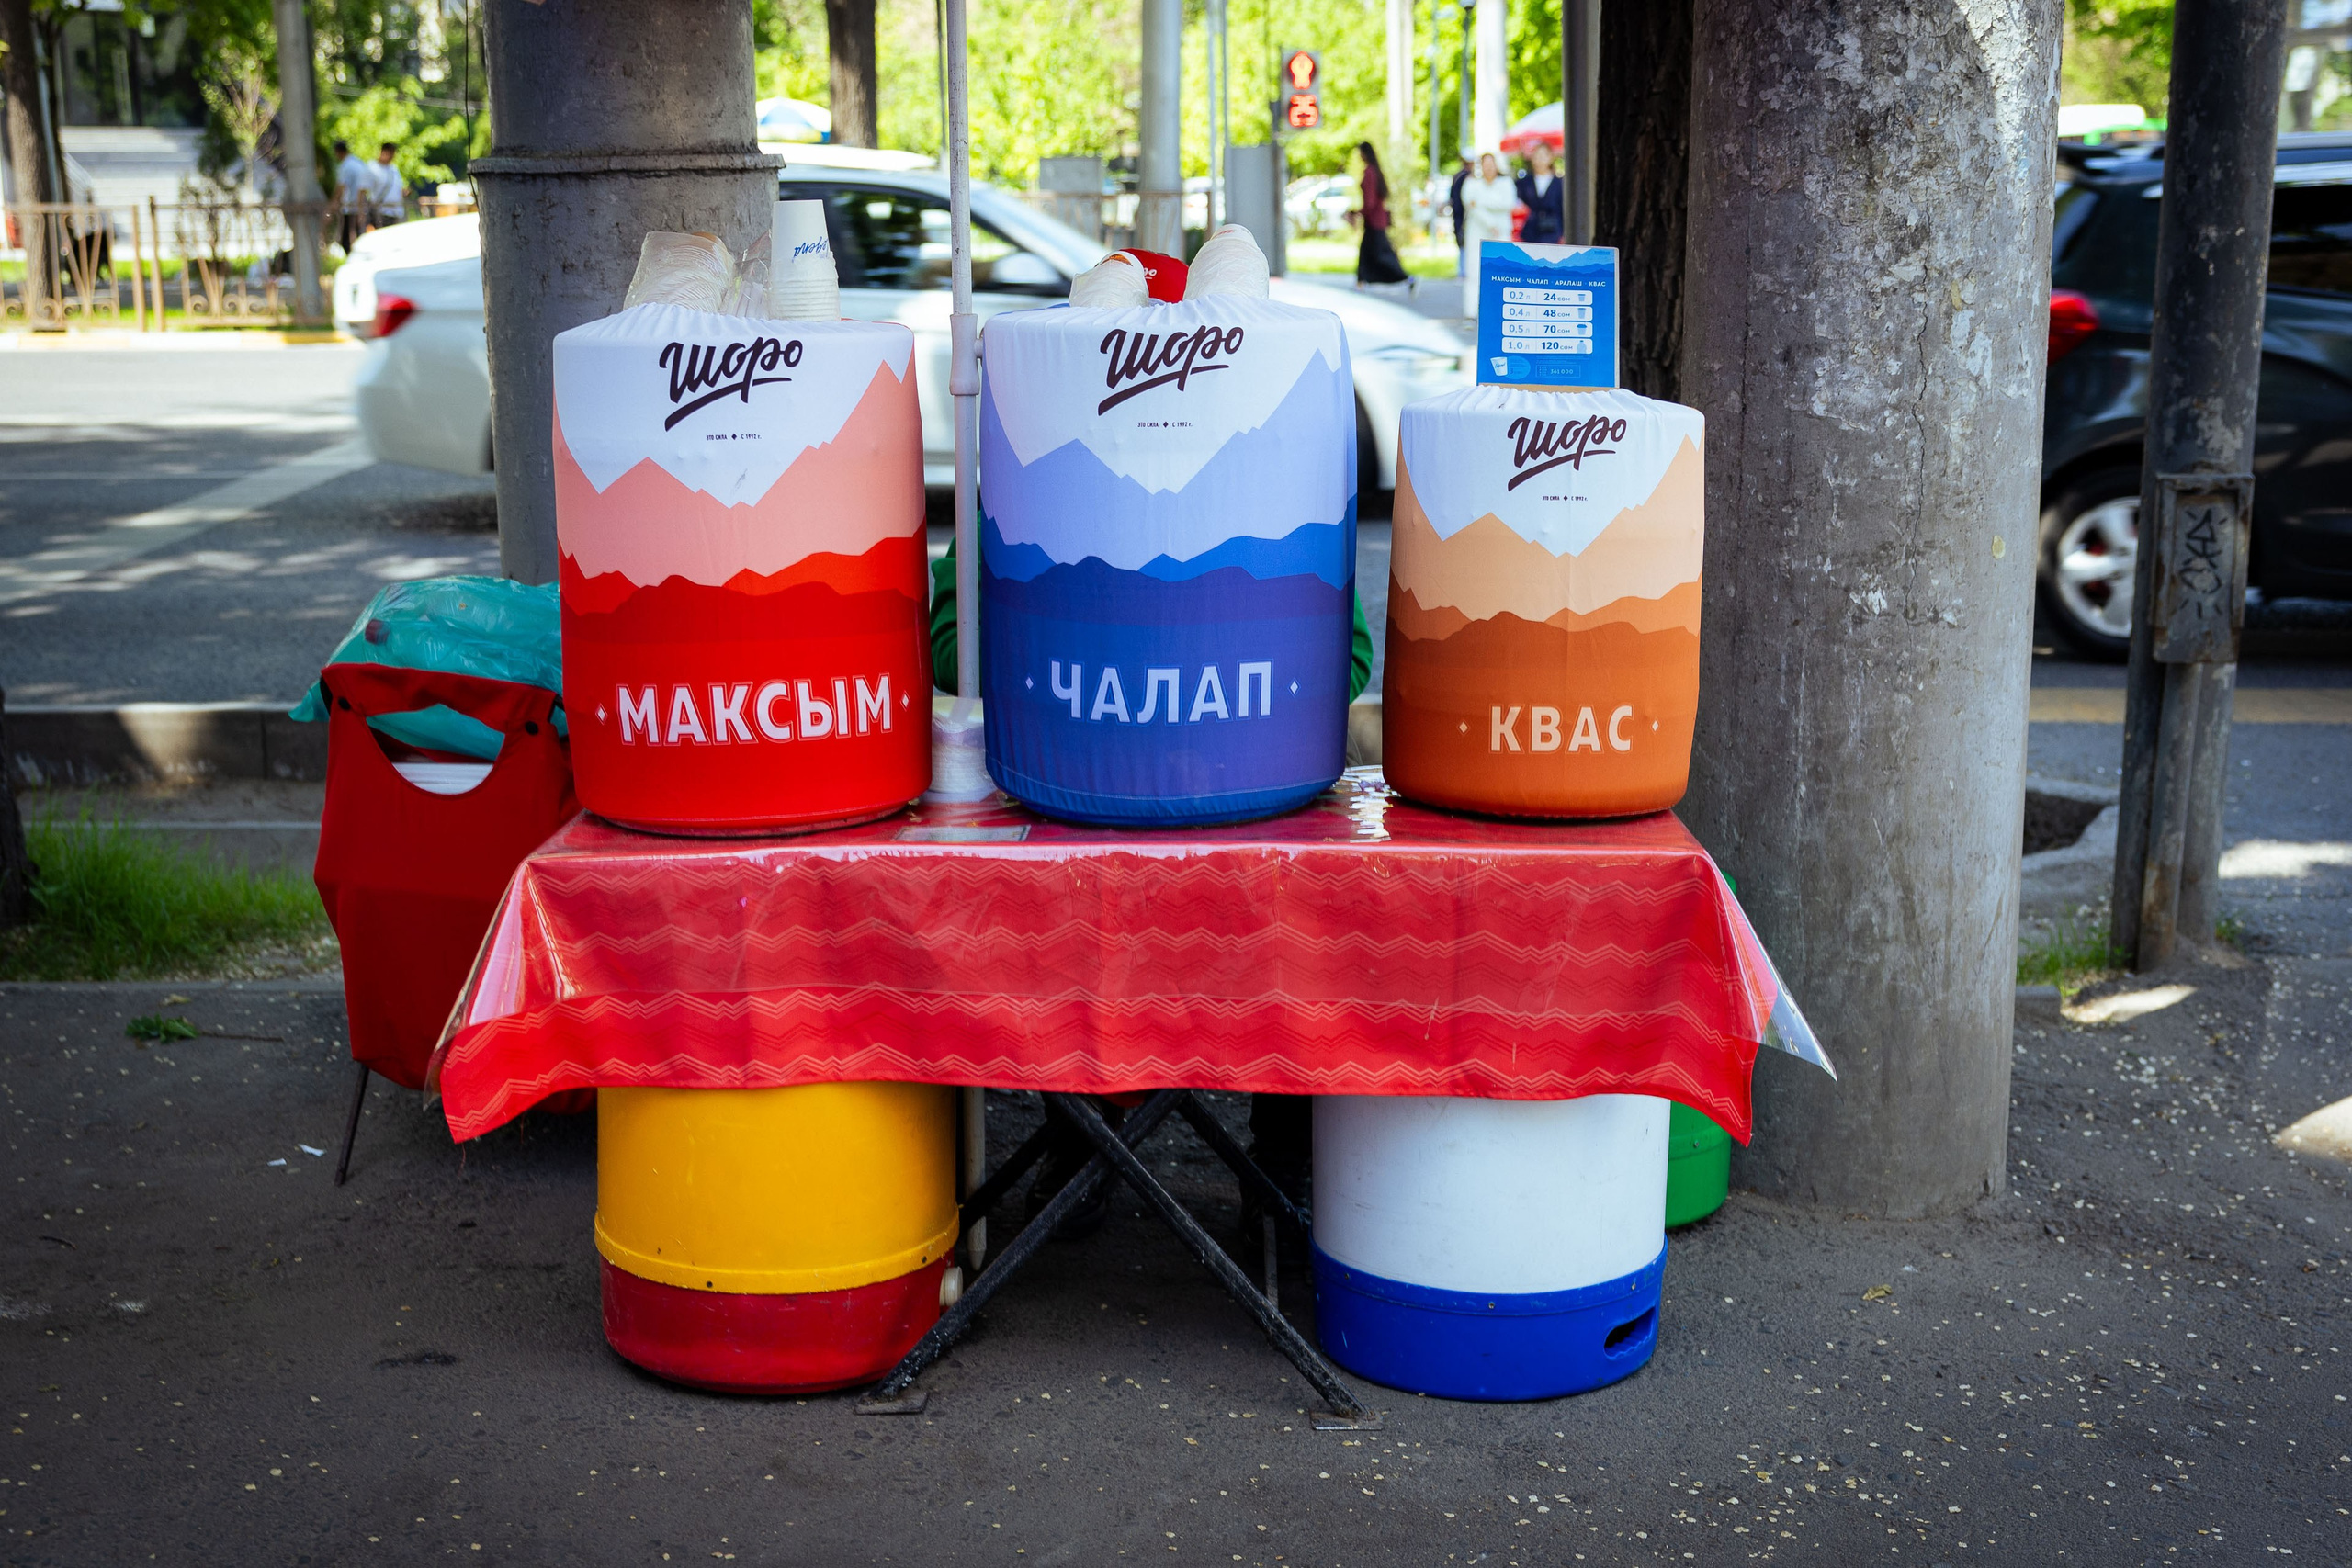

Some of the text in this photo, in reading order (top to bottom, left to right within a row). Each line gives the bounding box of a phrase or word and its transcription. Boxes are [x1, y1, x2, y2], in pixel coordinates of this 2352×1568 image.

[1544, 292, 1557, 301] 24
[1543, 309, 1556, 317] 48
[1544, 324, 1556, 333] 70
[1541, 341, 1559, 350] 120
[1049, 658, 1274, 726] ЧАЛАП
[616, 672, 893, 746] МАКСЫМ
[1489, 704, 1634, 754] КВАС
